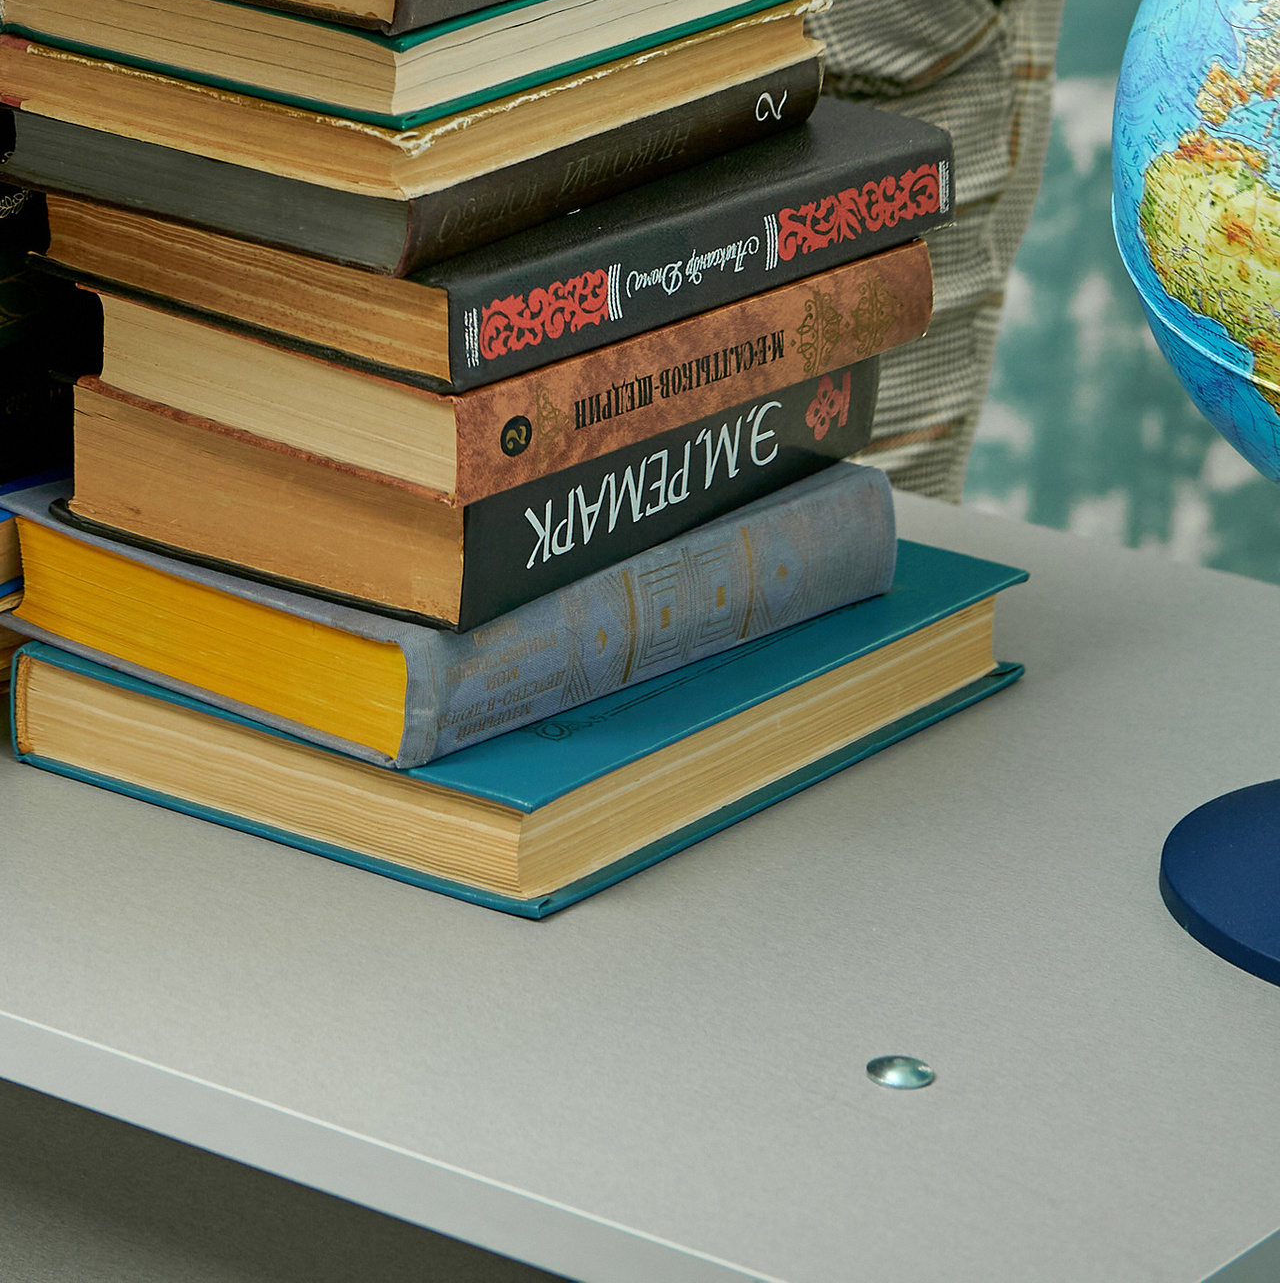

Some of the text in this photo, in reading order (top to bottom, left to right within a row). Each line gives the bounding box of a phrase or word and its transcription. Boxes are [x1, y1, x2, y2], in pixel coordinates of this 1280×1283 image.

[755, 90, 788, 122] 2
[626, 236, 760, 298] Александр Дюма
[504, 422, 529, 451] 2
